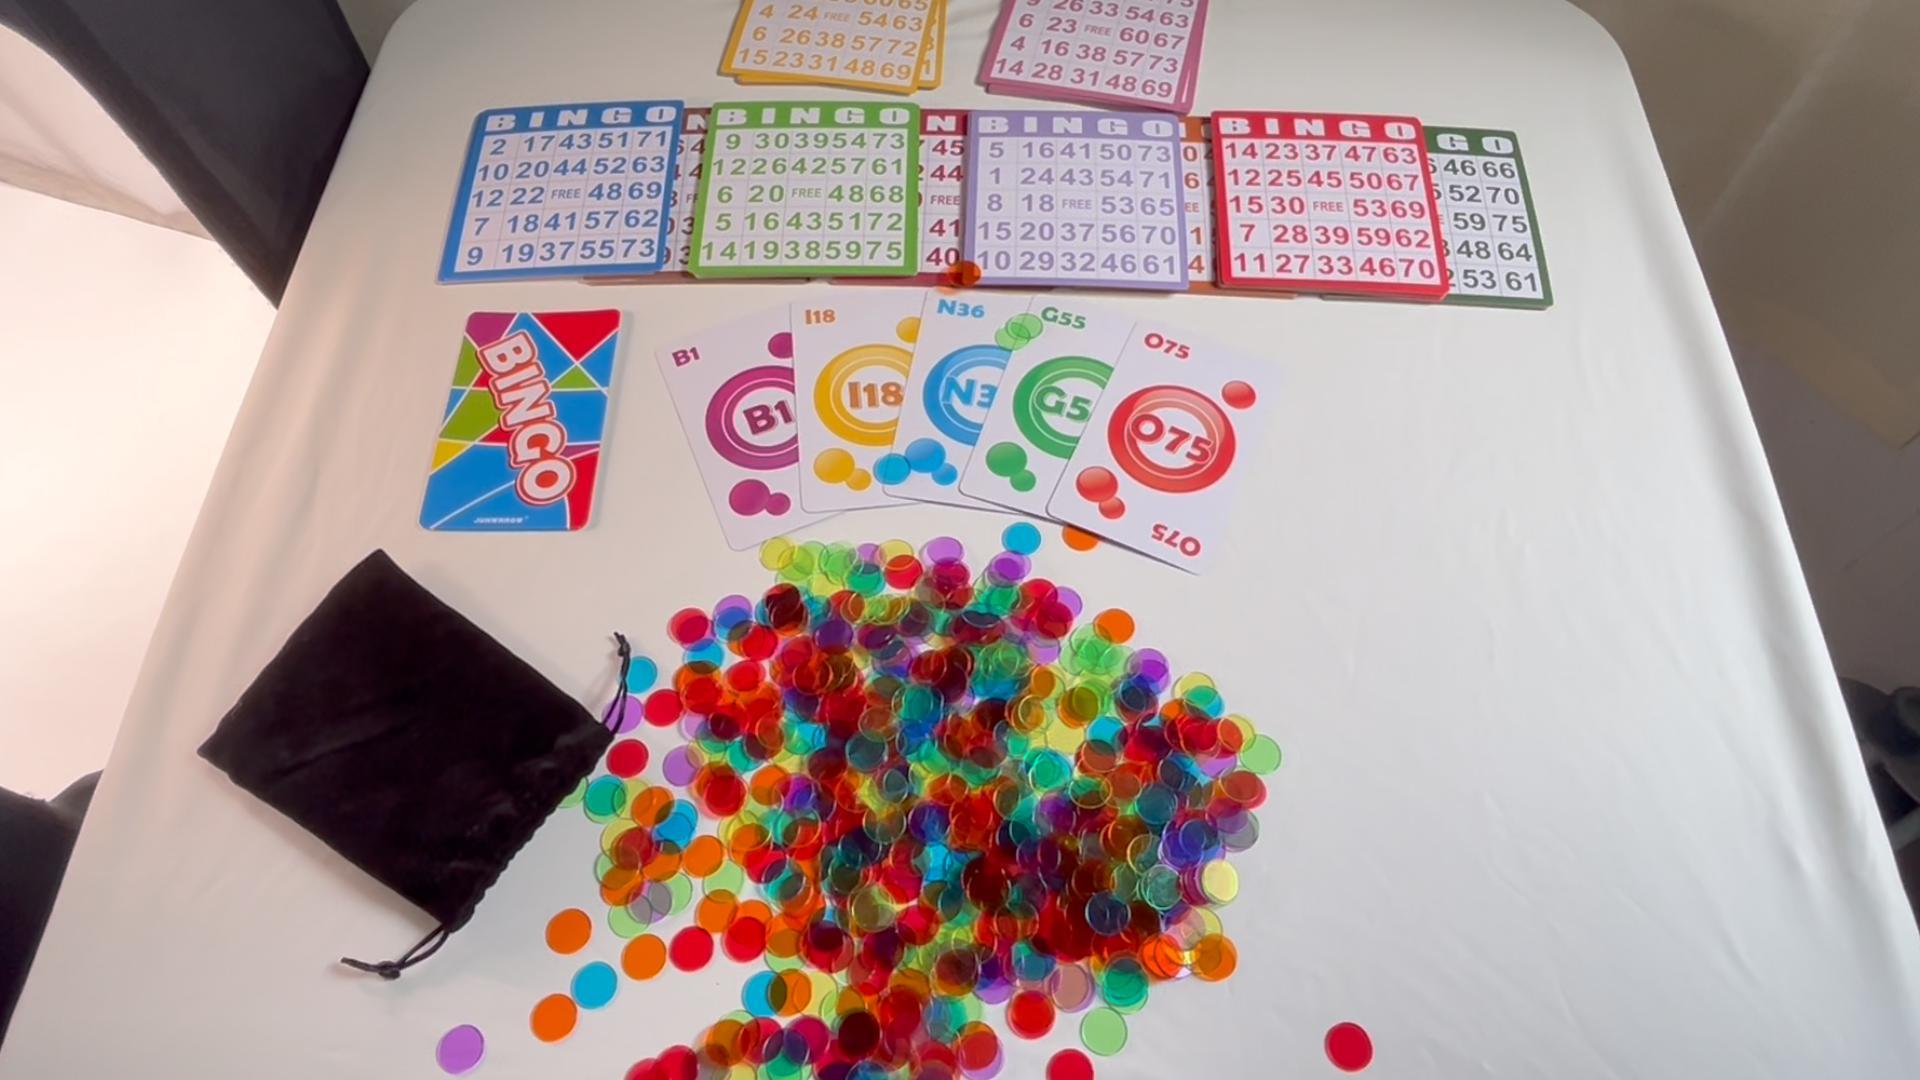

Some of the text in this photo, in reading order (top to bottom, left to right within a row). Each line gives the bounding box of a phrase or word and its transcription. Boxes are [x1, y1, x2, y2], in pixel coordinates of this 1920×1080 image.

[1019, 13, 1185, 50] 6 23 FREE 60 67
[739, 48, 911, 80] 15 23 31 48 69
[1010, 36, 1178, 73] 4 16 38 57 73
[996, 58, 1172, 98] 14 28 31 48 69
[490, 130, 666, 155] 2 17 43 51 71
[726, 132, 905, 150] 9 30 39 54 73
[932, 139, 964, 156] 45
[989, 142, 1171, 162] 5 16 41 50 73
[1225, 142, 1417, 164] 14 23 37 47 63
[478, 156, 665, 181] 10 20 44 52 63
[713, 157, 902, 175] 12 26 42 57 61
[930, 164, 964, 182] 44
[1443, 159, 1515, 179] 46 66
[990, 167, 1170, 189] 1 24 43 54 71
[1228, 169, 1419, 191] 12 25 45 50 67
[472, 181, 662, 208] 12 22 FREE 48 69
[717, 185, 904, 204] 6 20 FREE 48 68
[930, 195, 961, 205] FREE
[987, 193, 1175, 216] 8 18 FREE 53 65
[1449, 184, 1520, 205] 52 70
[1229, 195, 1426, 219] 15 30 FREE 53 69
[474, 209, 659, 236] 7 18 41 57 62
[715, 212, 903, 231] 5 16 43 51 72
[929, 218, 961, 238] 41
[978, 221, 1176, 245] 15 20 37 56 70
[1453, 212, 1528, 233] 59 75
[1240, 224, 1430, 248] 7 28 39 59 62
[467, 238, 655, 266] 9 19 37 55 73
[701, 240, 902, 260] 14 19 38 59 75
[1456, 240, 1533, 262] 48 64
[977, 251, 1174, 275] 10 29 32 46 61
[1234, 253, 1435, 279] 11 27 33 46 70
[1463, 269, 1537, 292] 53 61
[805, 309, 836, 324] I18
[937, 299, 986, 318] N36
[1041, 306, 1086, 330] G55
[672, 347, 700, 367] B1
[1144, 332, 1190, 360] O75
[848, 381, 905, 409] I18
[478, 330, 575, 505] BINGO
[743, 400, 796, 435] B1
[1130, 413, 1213, 464] O75
[1152, 523, 1201, 557] O75
